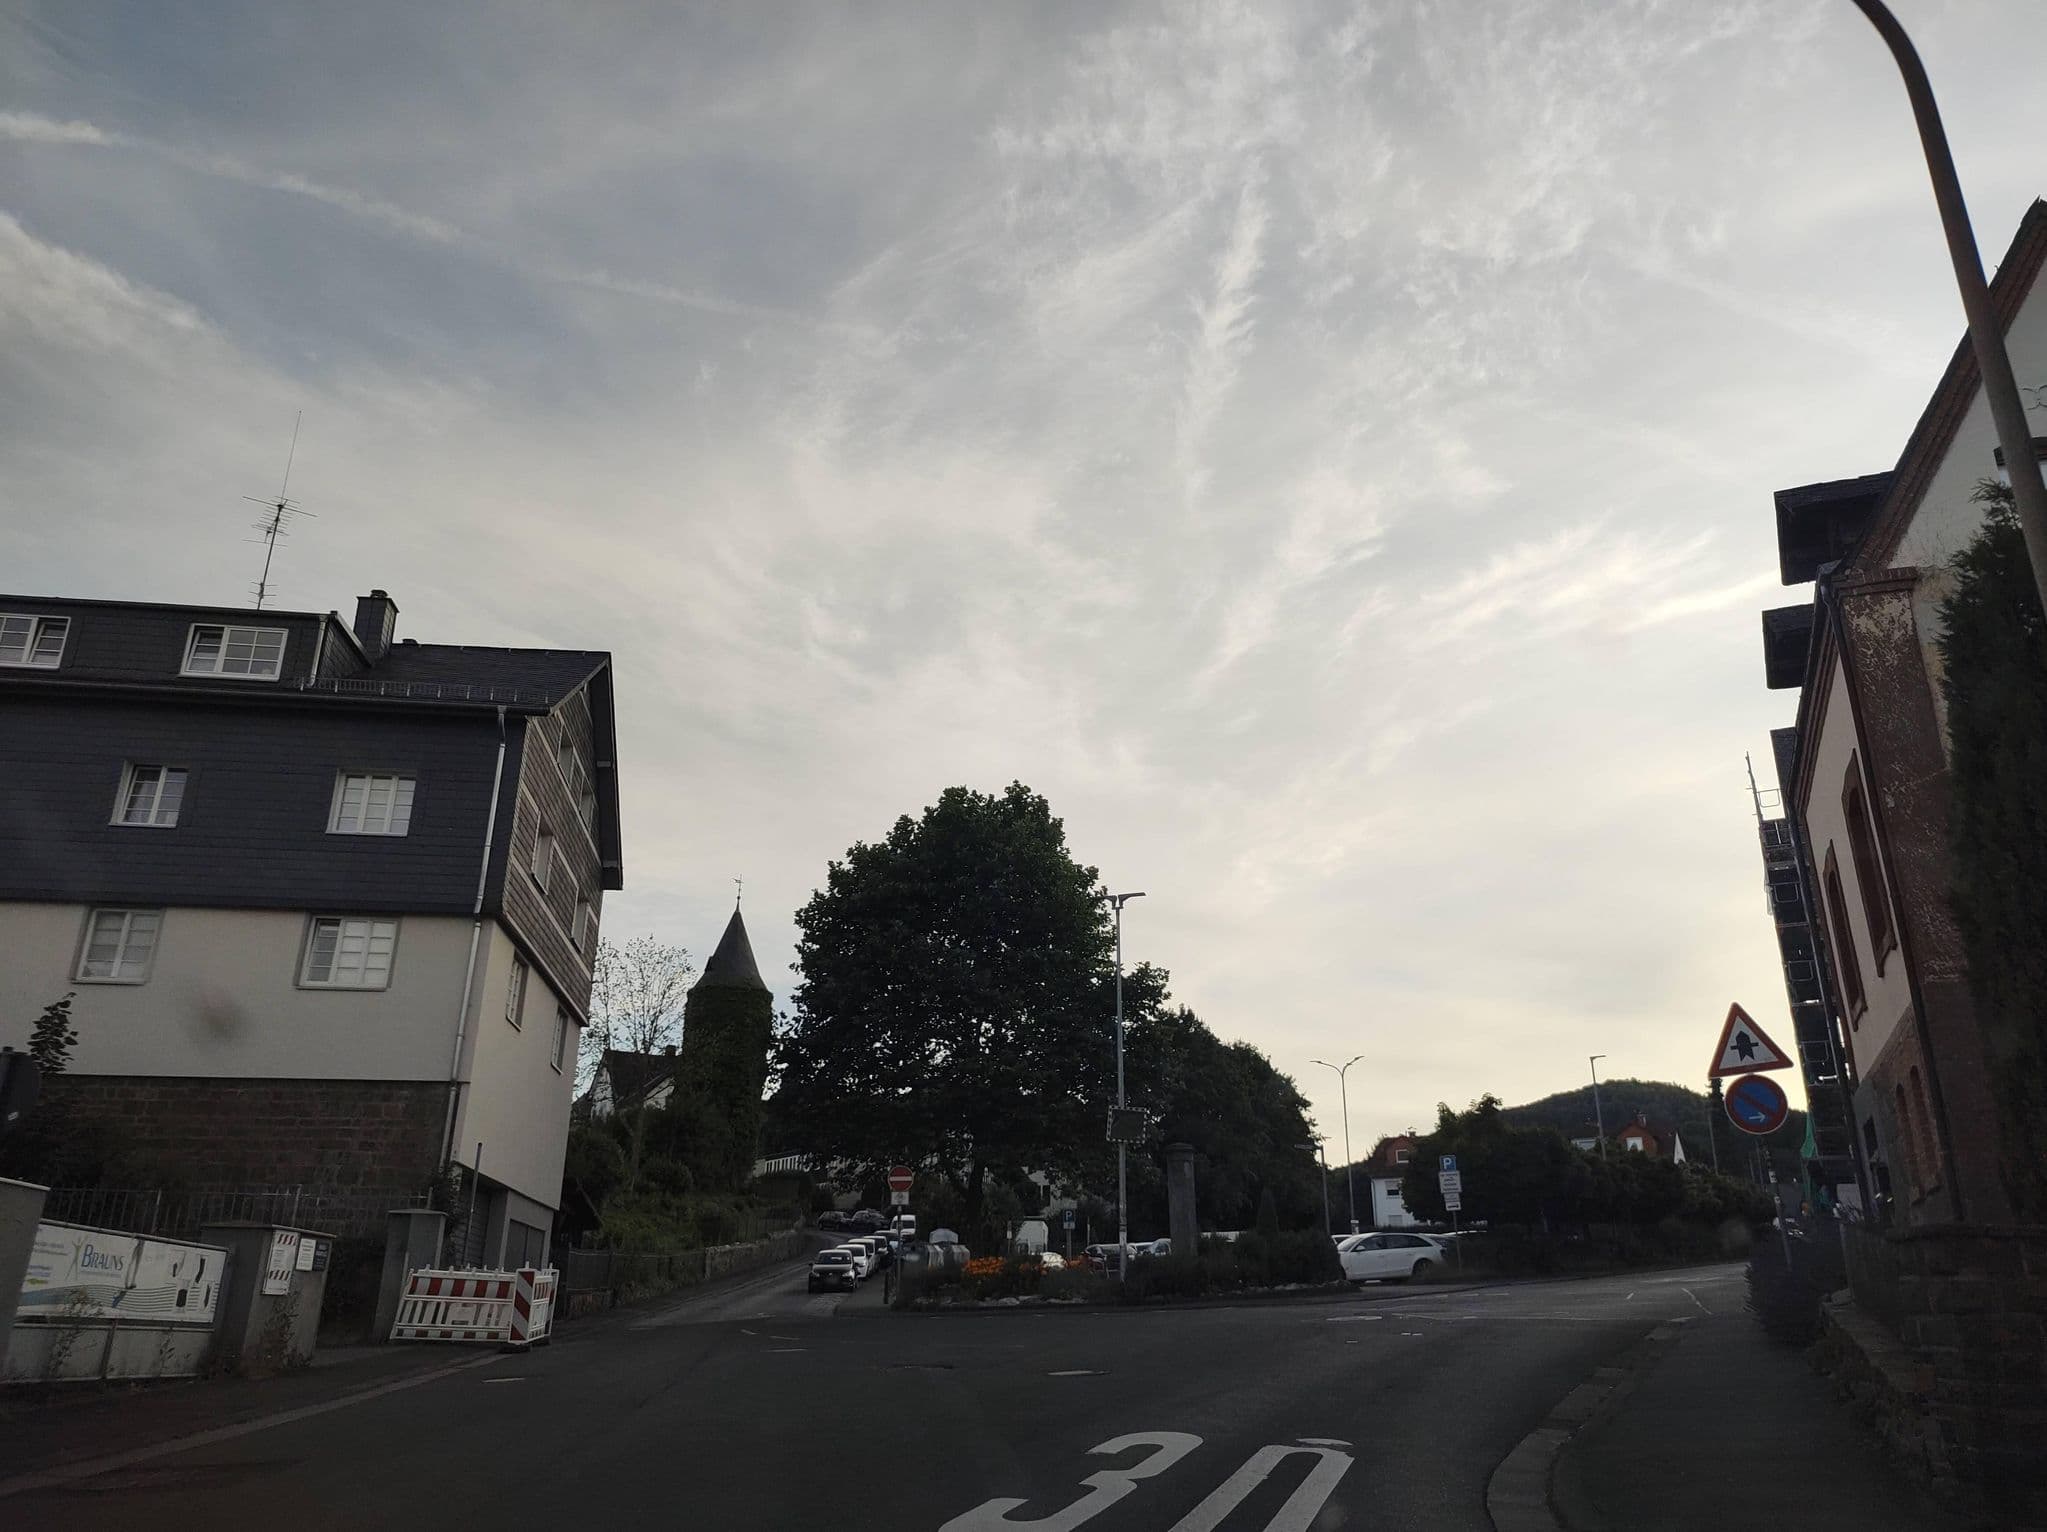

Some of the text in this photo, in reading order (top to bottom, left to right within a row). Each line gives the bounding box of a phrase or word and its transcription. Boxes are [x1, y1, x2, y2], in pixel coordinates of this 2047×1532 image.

[1443, 1157, 1452, 1170] P
[1065, 1210, 1073, 1221] P
[81, 1244, 125, 1271] BRAUNS
[938, 1430, 1354, 1532] 30
